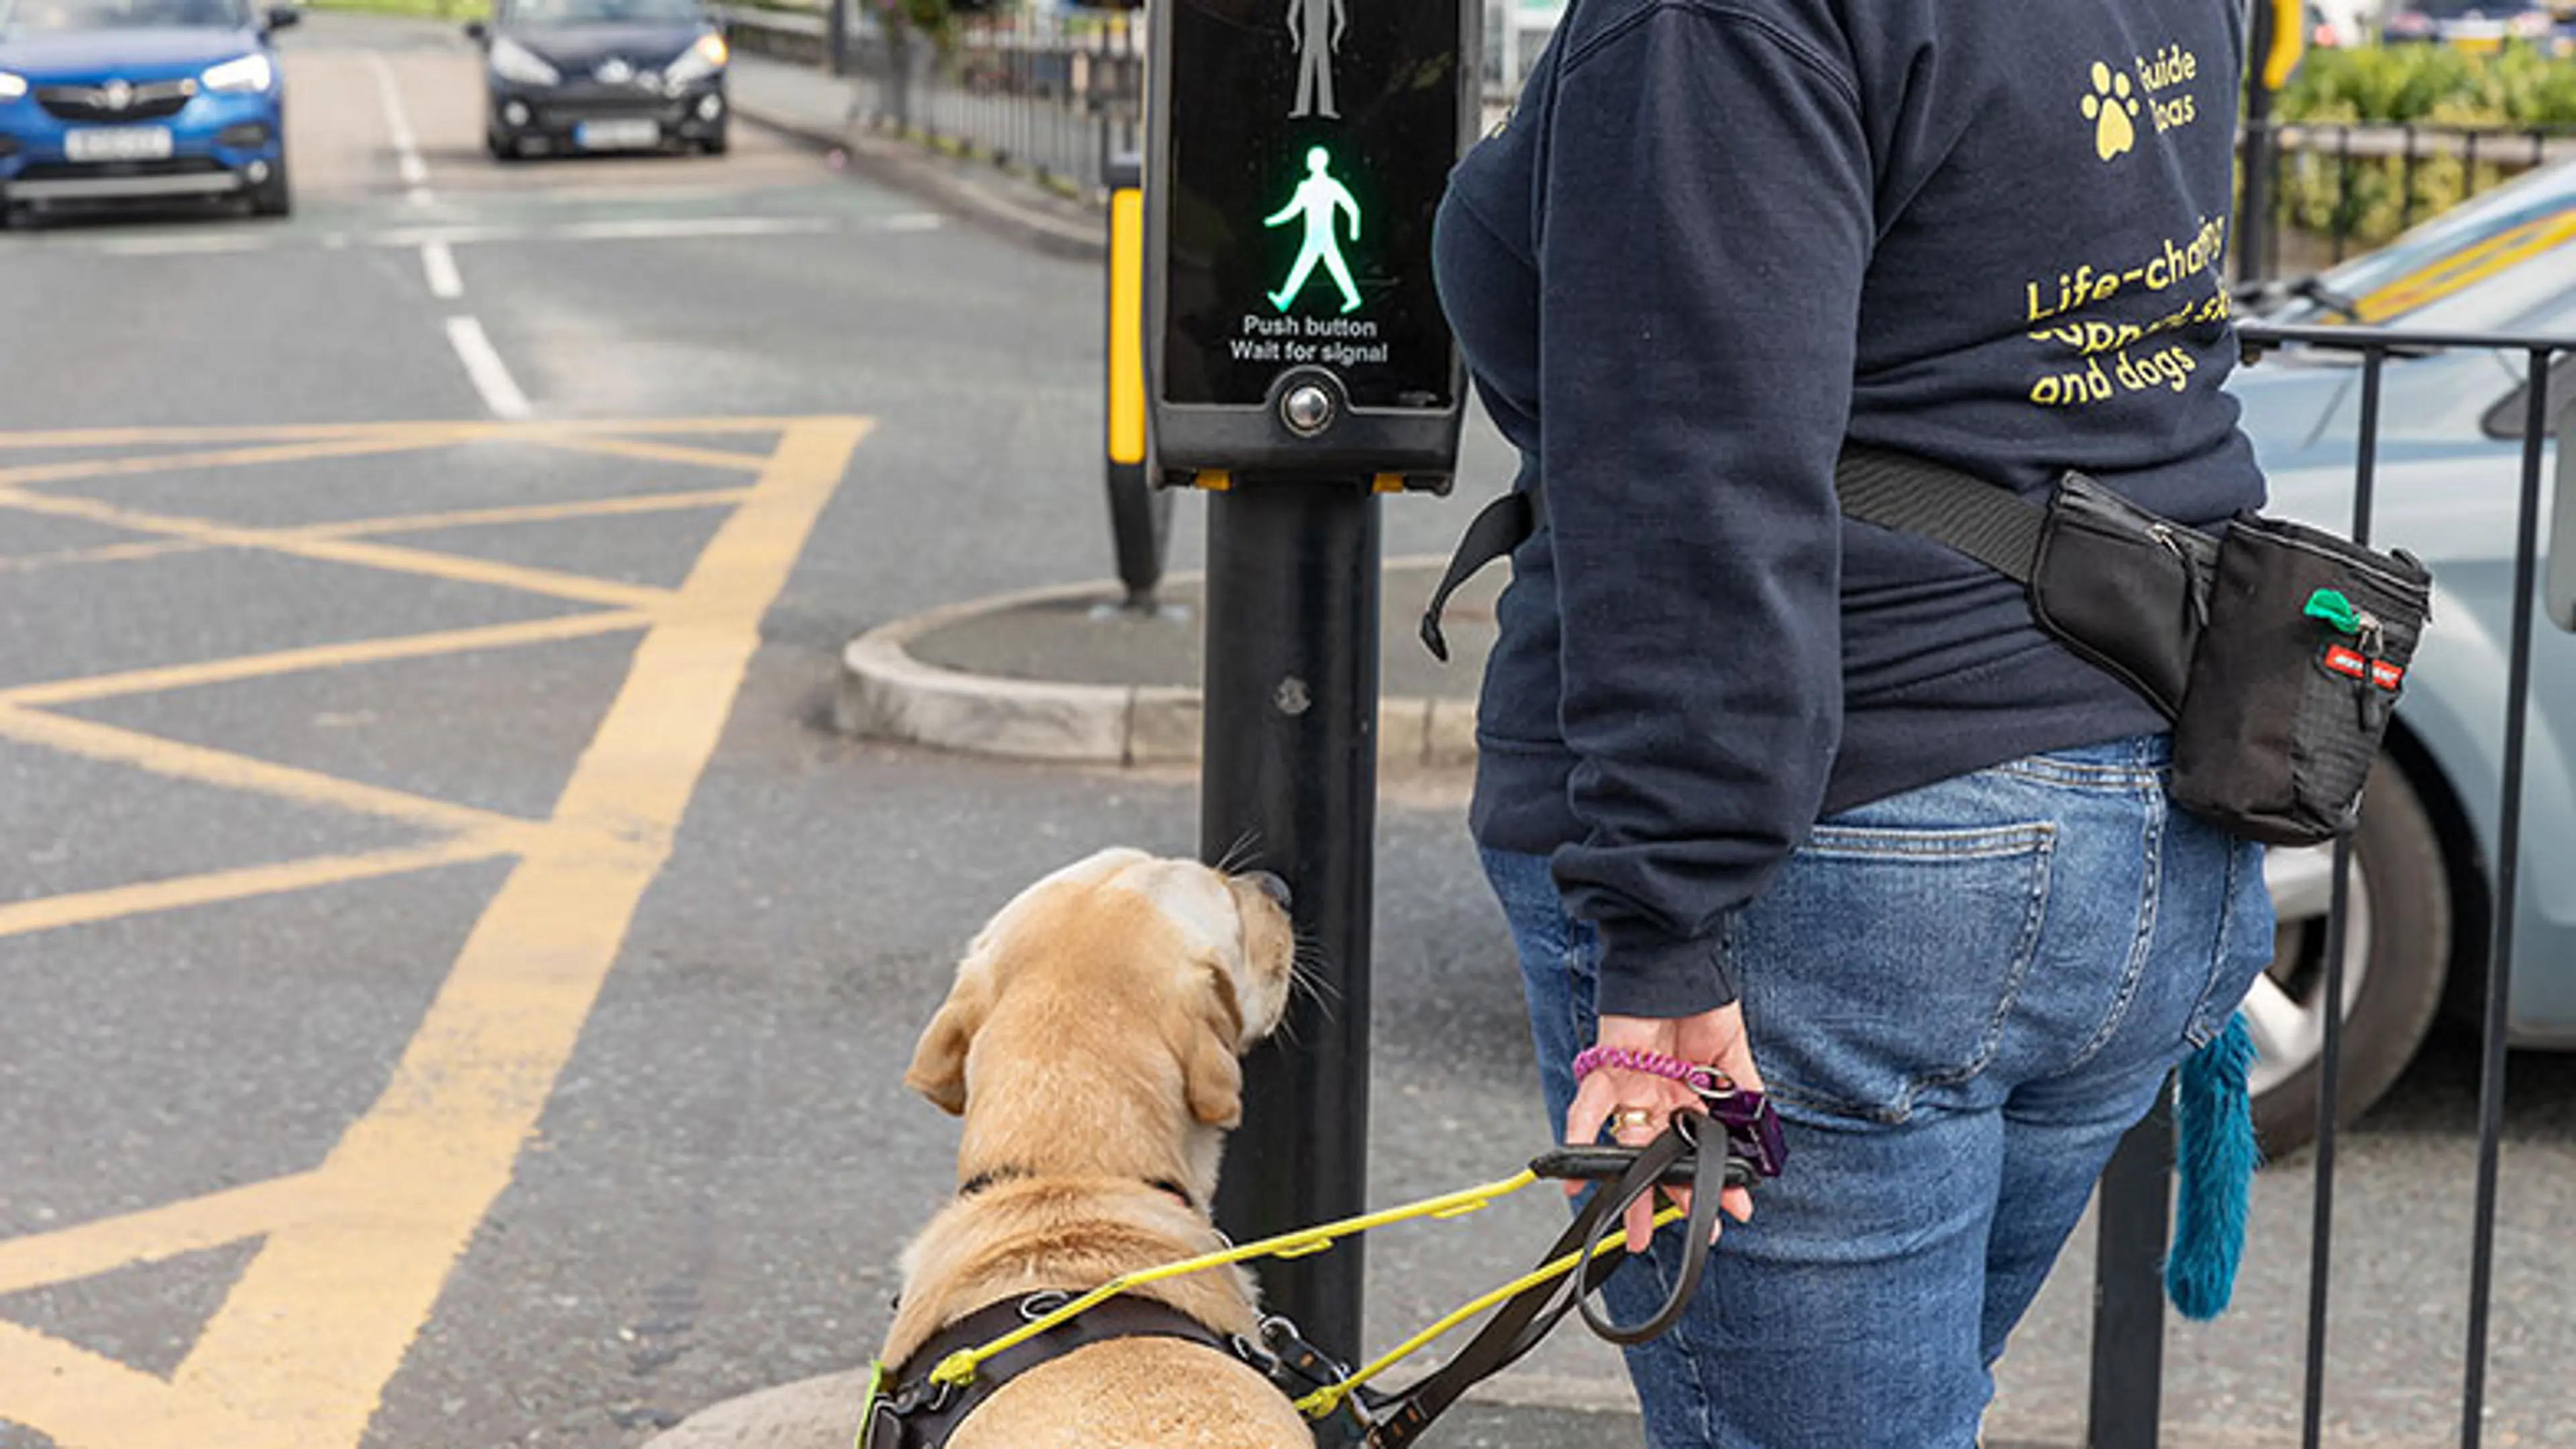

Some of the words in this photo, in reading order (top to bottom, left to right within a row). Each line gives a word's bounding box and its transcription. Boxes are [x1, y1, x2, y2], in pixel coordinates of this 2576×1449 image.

[1244, 315, 1299, 335] Push
[1305, 315, 1377, 336] button
[1230, 339, 1280, 360] Wait
[1285, 340, 1317, 361] for
[1320, 341, 1389, 366] signal
[2029, 356, 2112, 404] and
[2116, 345, 2196, 391] dogs
